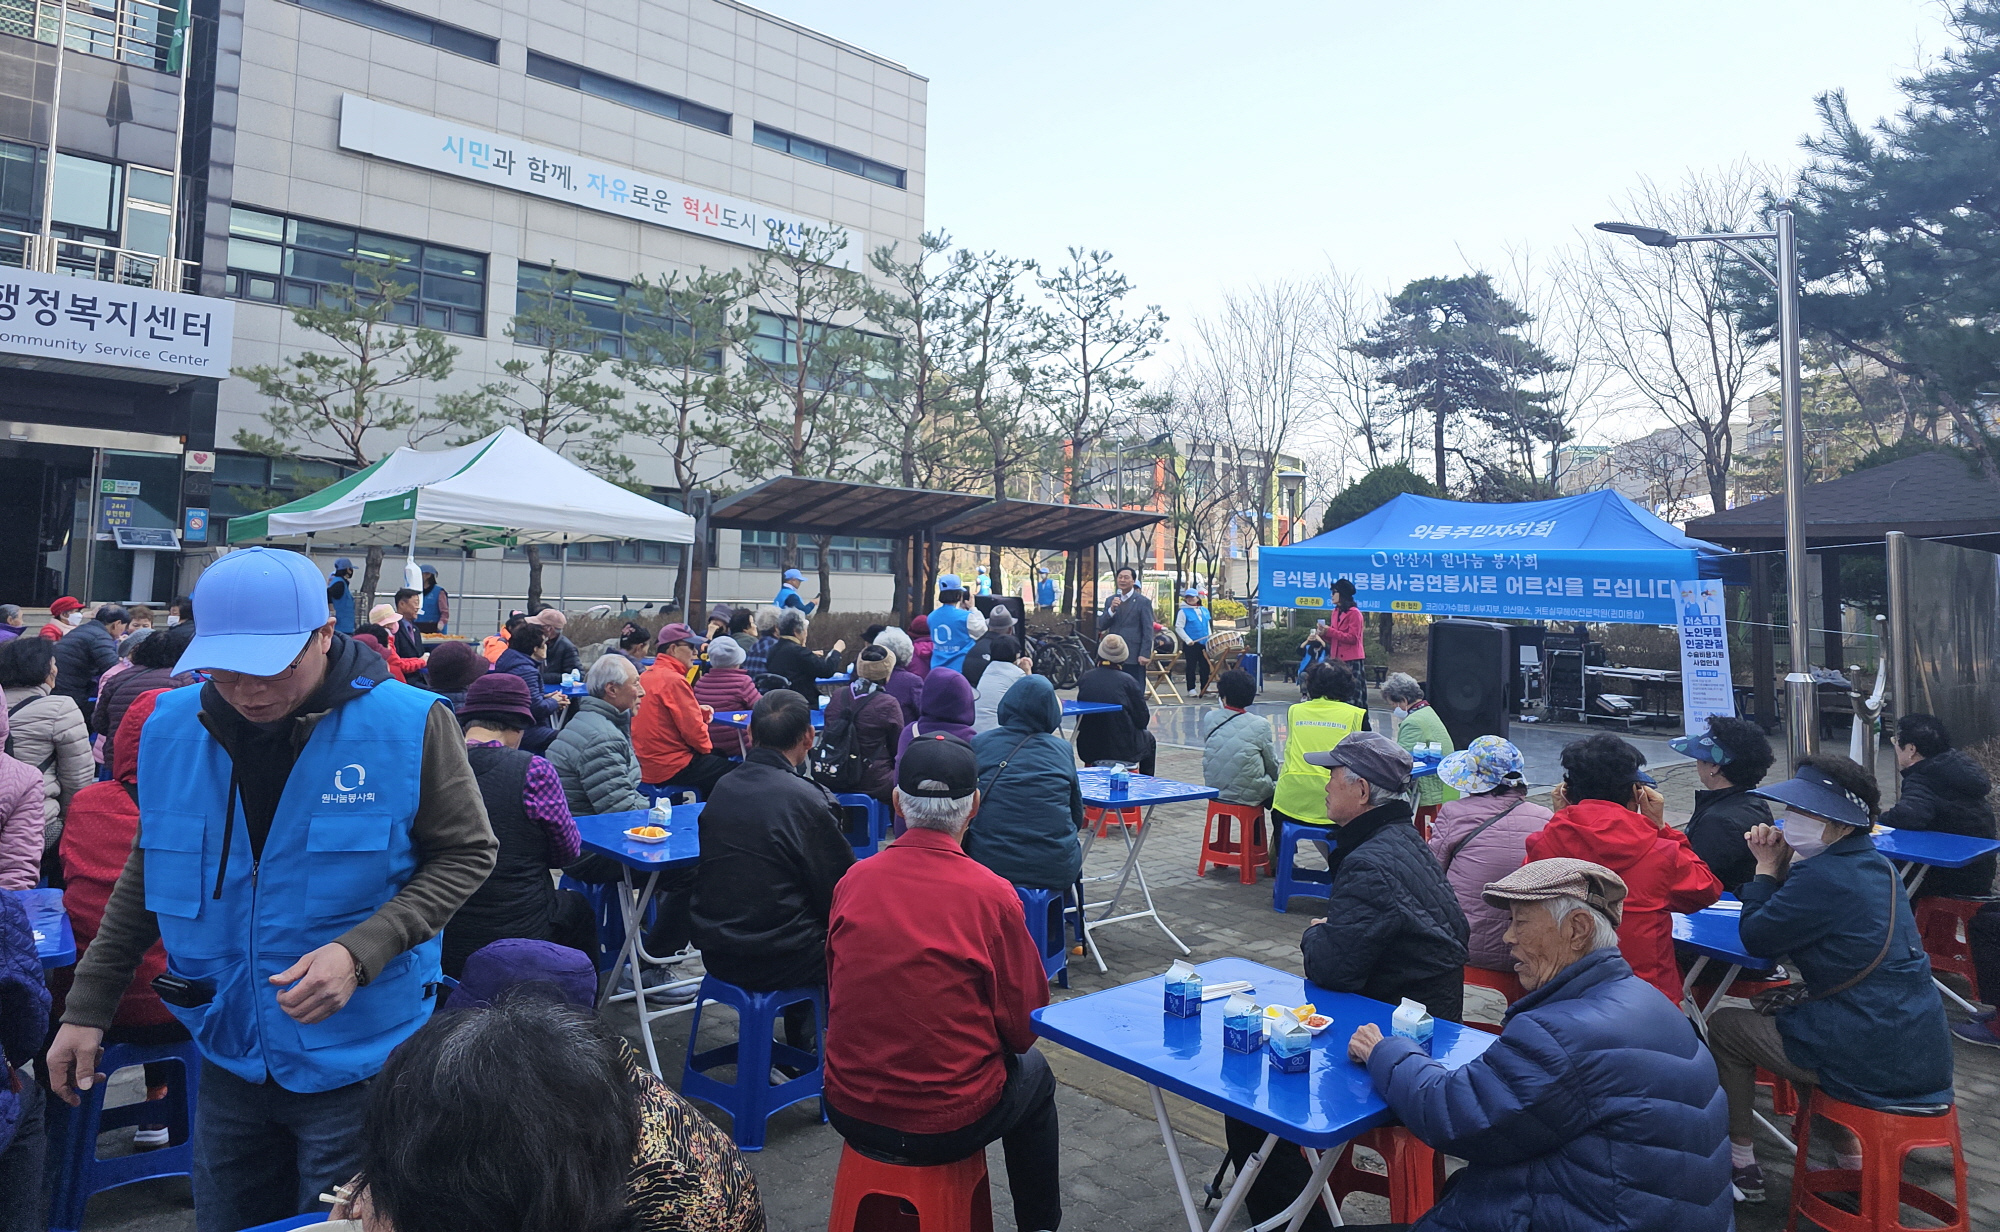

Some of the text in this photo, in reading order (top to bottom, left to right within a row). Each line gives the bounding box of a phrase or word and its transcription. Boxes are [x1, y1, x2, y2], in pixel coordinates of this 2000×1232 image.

[442, 135, 802, 248] 시민과 함께, 자유로운 혁신도시 안산
[0, 283, 212, 347] 행정복지센터
[94, 342, 151, 360] Service
[158, 350, 210, 367] Center
[1408, 520, 1557, 540] 와동주민자치회
[1392, 551, 1538, 571] 안산시 원나눔 봉사회
[1505, 575, 1584, 597] 어르신을
[1592, 578, 1676, 599] 모십니다
[1685, 639, 1724, 650] 인공관절
[321, 792, 376, 804] 원나눔봉사회
